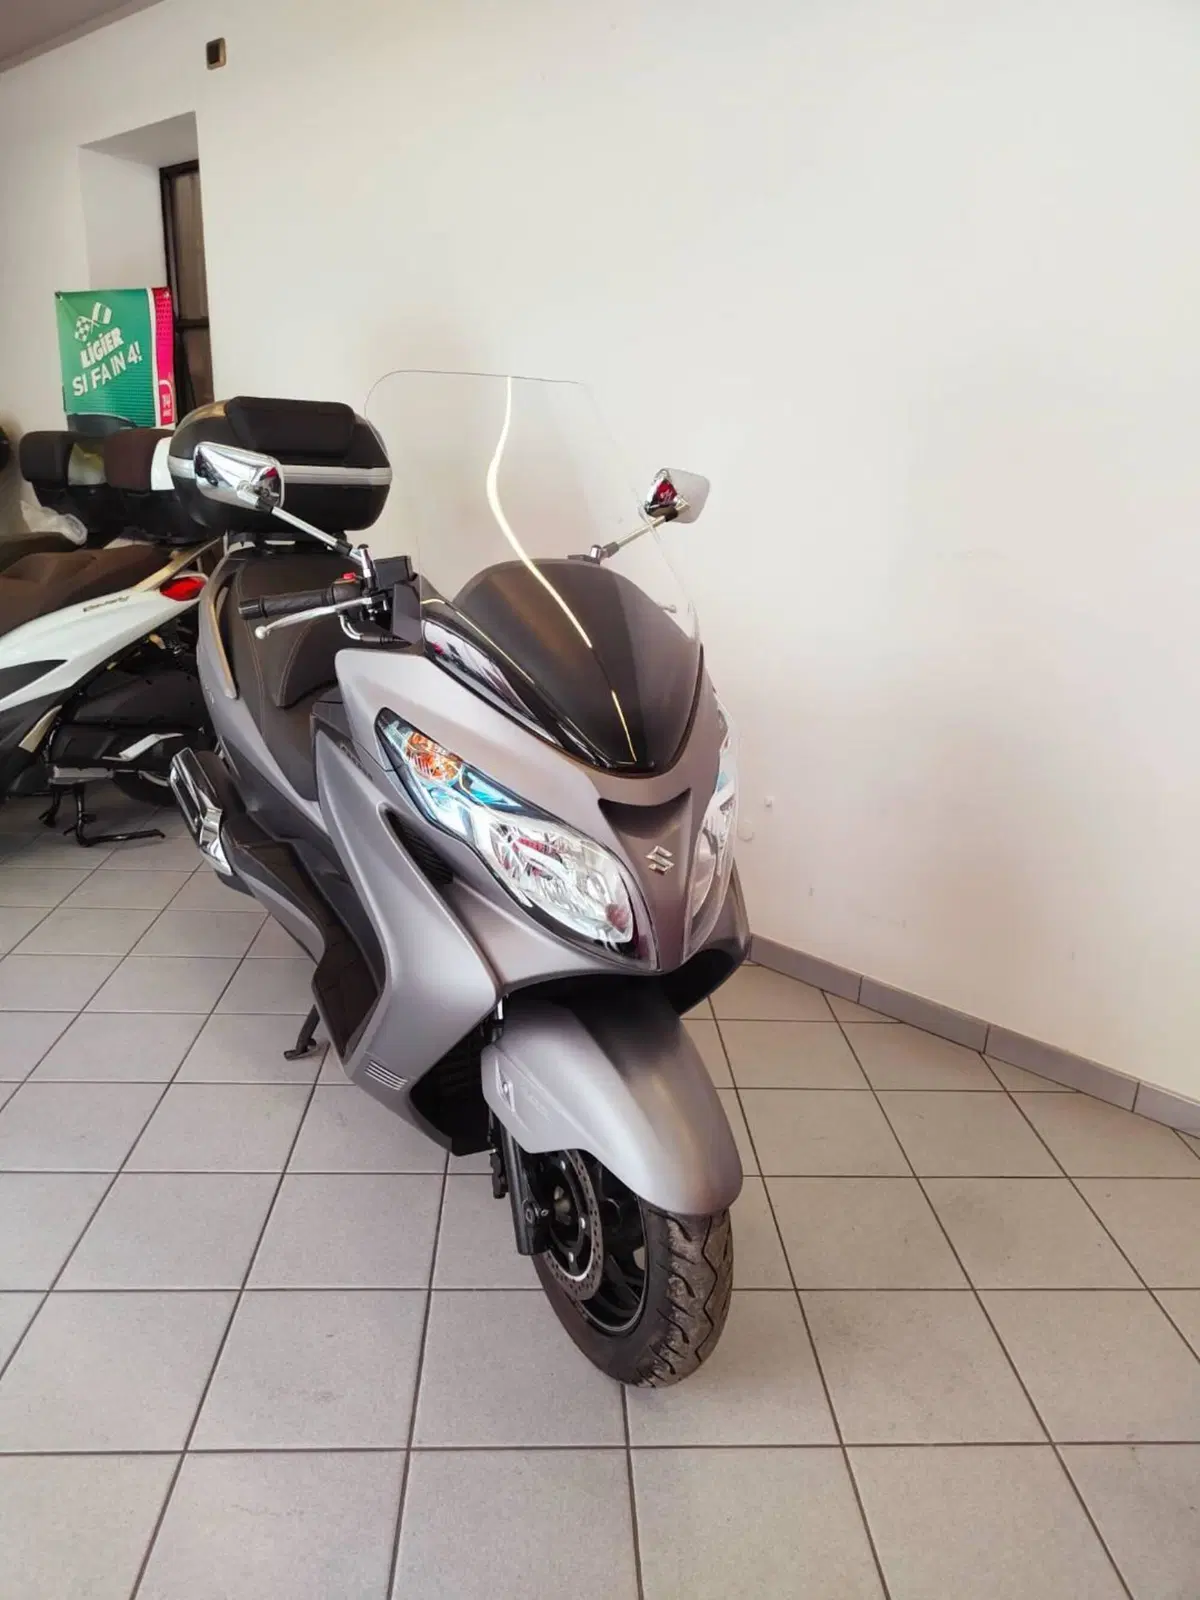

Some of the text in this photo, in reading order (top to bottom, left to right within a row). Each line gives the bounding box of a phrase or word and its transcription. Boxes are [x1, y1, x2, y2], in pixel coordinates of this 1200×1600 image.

[72, 341, 143, 396] SI FA IN 4!
